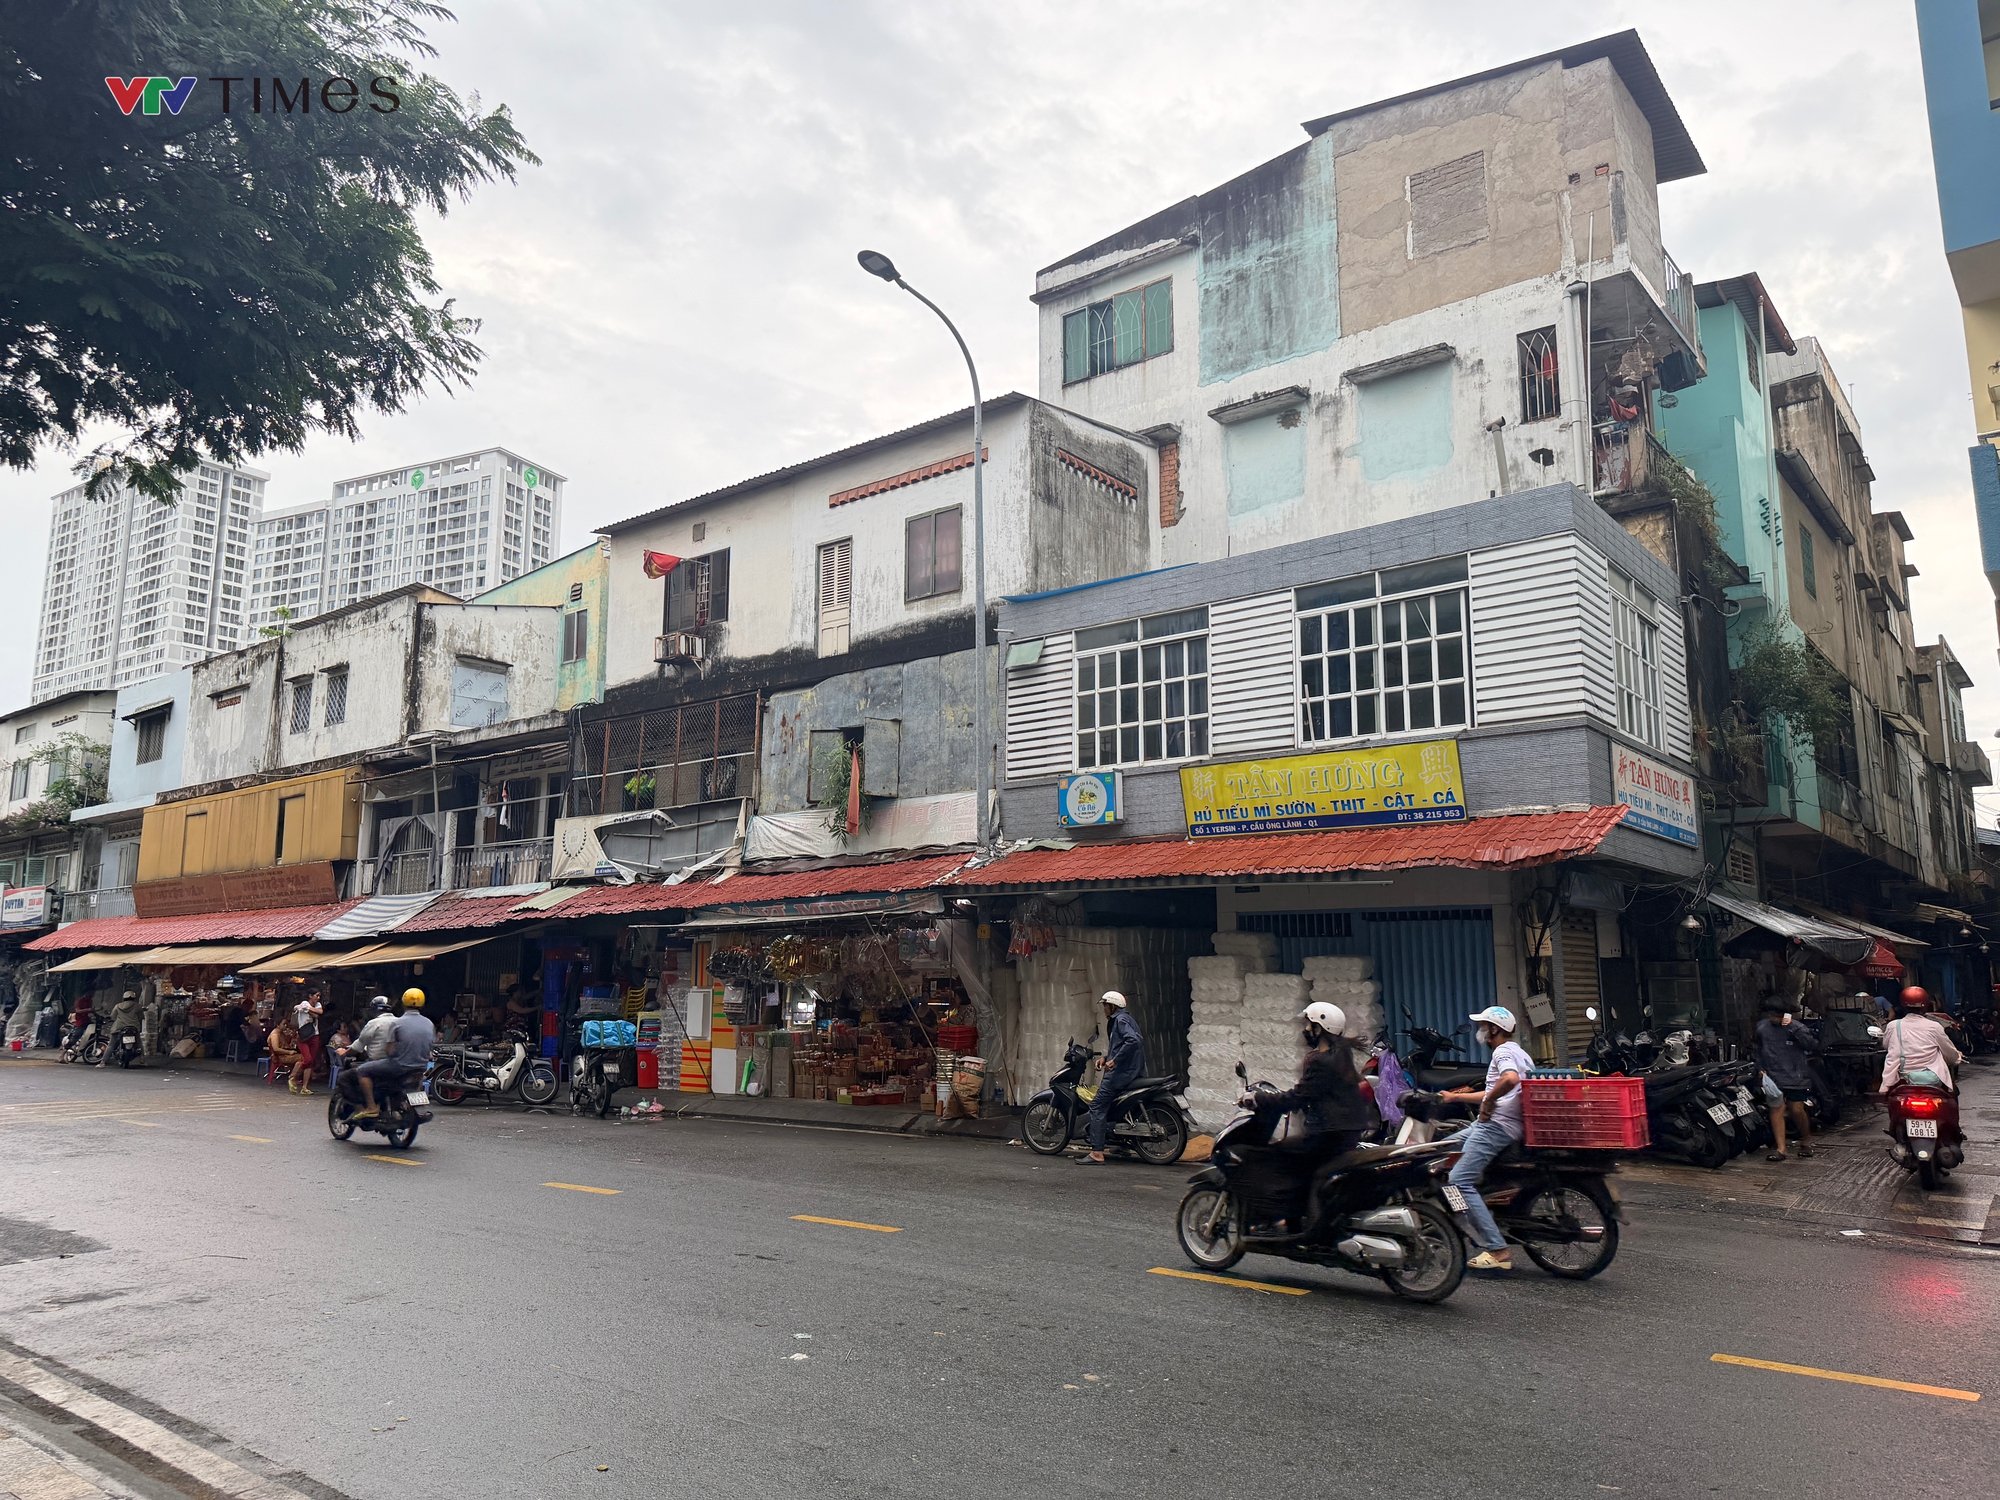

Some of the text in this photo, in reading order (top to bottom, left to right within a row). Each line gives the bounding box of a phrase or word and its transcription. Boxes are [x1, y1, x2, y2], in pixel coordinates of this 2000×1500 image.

[1225, 757, 1404, 800] TÂN HƯNG
[1419, 744, 1454, 784] 興
[1629, 758, 1680, 801] TÂN HƯNG
[1192, 769, 1217, 803] 新
[1194, 806, 1212, 822] HỦ
[1217, 804, 1249, 820] TIẾU
[1254, 803, 1271, 818] MÌ
[1276, 800, 1316, 816] SƯỜN
[1330, 798, 1366, 813] THỊT
[1383, 792, 1414, 810] CẬT
[1433, 788, 1456, 804] CÁ
[1629, 792, 1643, 809] TIẾU
[1645, 798, 1652, 812] MÌ
[1656, 804, 1668, 820] THỊT
[1672, 809, 1682, 825] CẬT
[1686, 814, 1694, 827] CÁ
[1195, 826, 1204, 834] SỐ
[1250, 821, 1264, 830] CẦU
[1266, 821, 1281, 829] ÔNG
